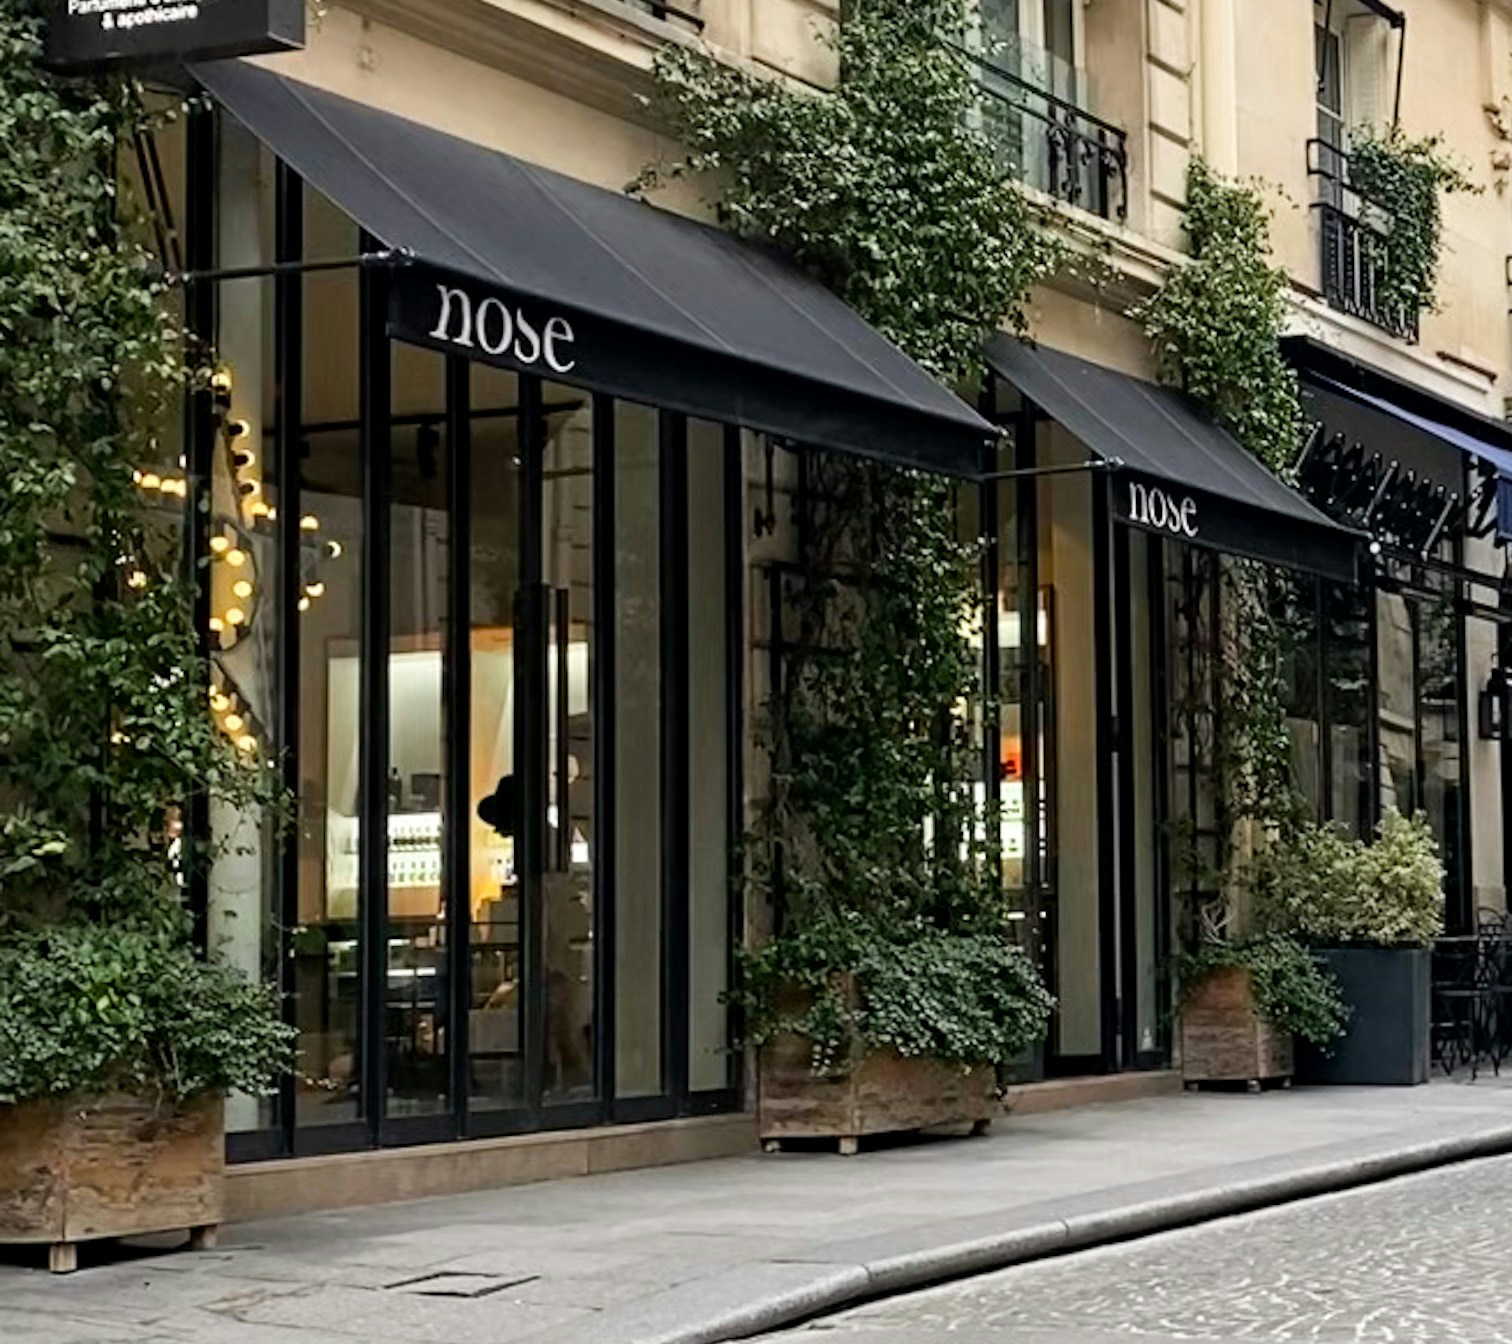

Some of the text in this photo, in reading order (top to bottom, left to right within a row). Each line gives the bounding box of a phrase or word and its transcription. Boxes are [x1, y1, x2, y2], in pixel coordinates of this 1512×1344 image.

[101, 3, 199, 31] & apothicaire
[428, 282, 577, 373] nose
[1128, 480, 1200, 538] nose
